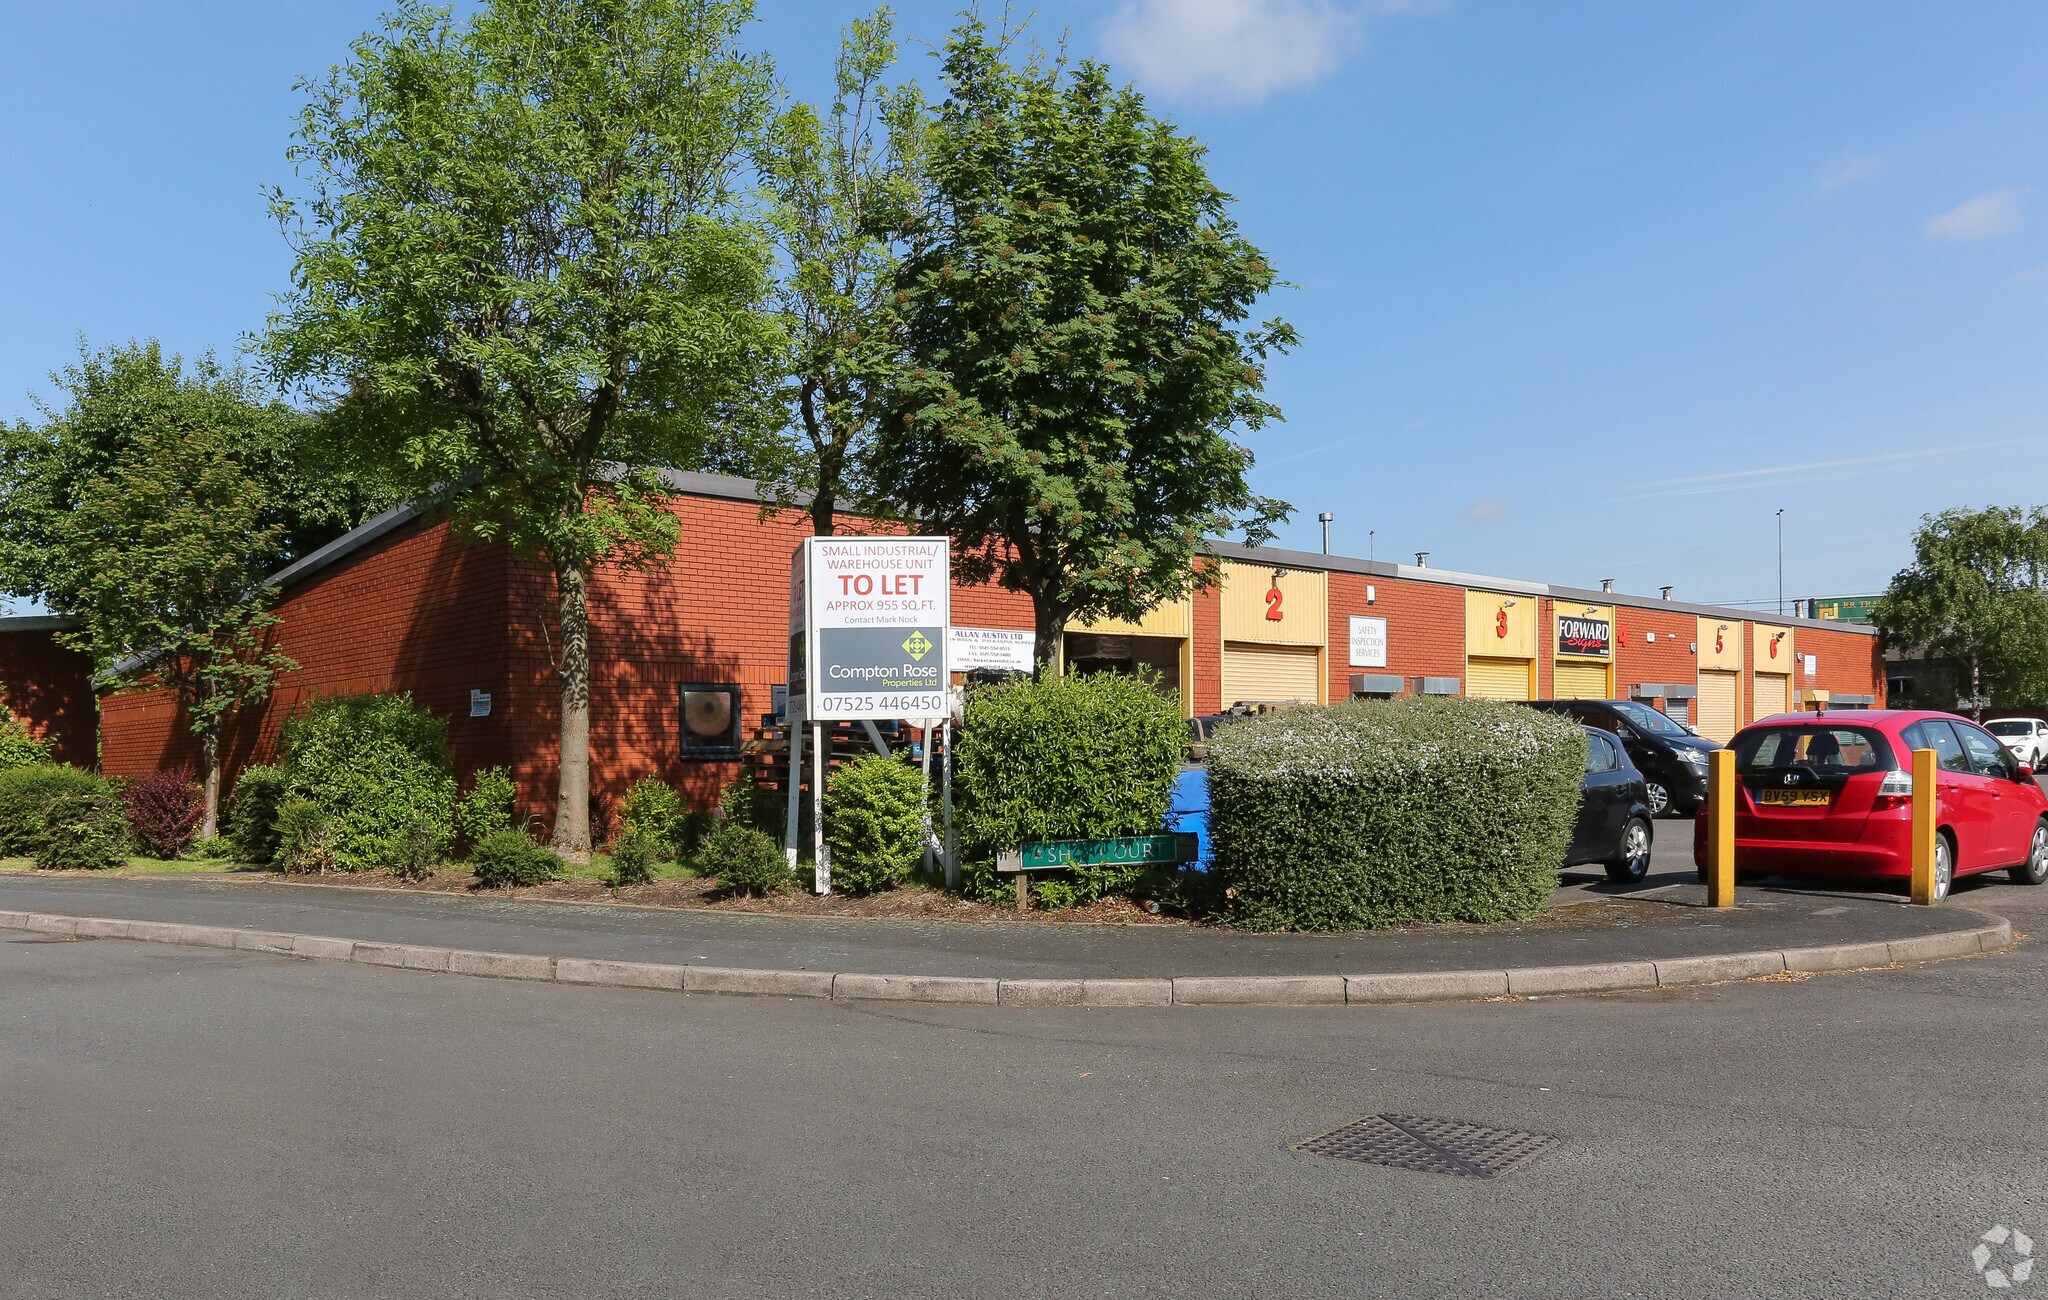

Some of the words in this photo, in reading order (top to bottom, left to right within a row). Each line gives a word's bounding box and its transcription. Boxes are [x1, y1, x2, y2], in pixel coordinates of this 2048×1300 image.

[822, 546, 860, 556] SMALL
[864, 545, 939, 557] INDUSTRIAL/
[827, 559, 902, 569] WAREHOUSE
[906, 559, 934, 569] UNIT
[838, 574, 874, 596] TO
[881, 574, 924, 596] LET
[826, 600, 874, 611] APPROX
[877, 600, 898, 610] 955
[901, 600, 936, 611] SQ.FT.
[1266, 588, 1283, 621] 2
[844, 616, 874, 624] Contact
[876, 616, 897, 624] Mark
[1496, 610, 1508, 638] 3
[982, 632, 1008, 640] AUSTIN
[1358, 626, 1377, 634] SAFETY
[1559, 620, 1609, 640] FORWARD
[1618, 624, 1630, 648] 4
[1352, 637, 1384, 646] INSPECTION
[1567, 633, 1602, 653] Signs
[1715, 635, 1723, 653] 5
[1356, 648, 1380, 657] SERVICES
[1769, 639, 1779, 659] 6
[829, 665, 899, 681] Compton
[903, 664, 938, 677] Rose
[882, 679, 923, 688] Properties
[823, 697, 875, 711] 07525
[879, 695, 942, 711] 446450
[1764, 791, 1798, 801] BV59
[1801, 791, 1828, 802] YSX
